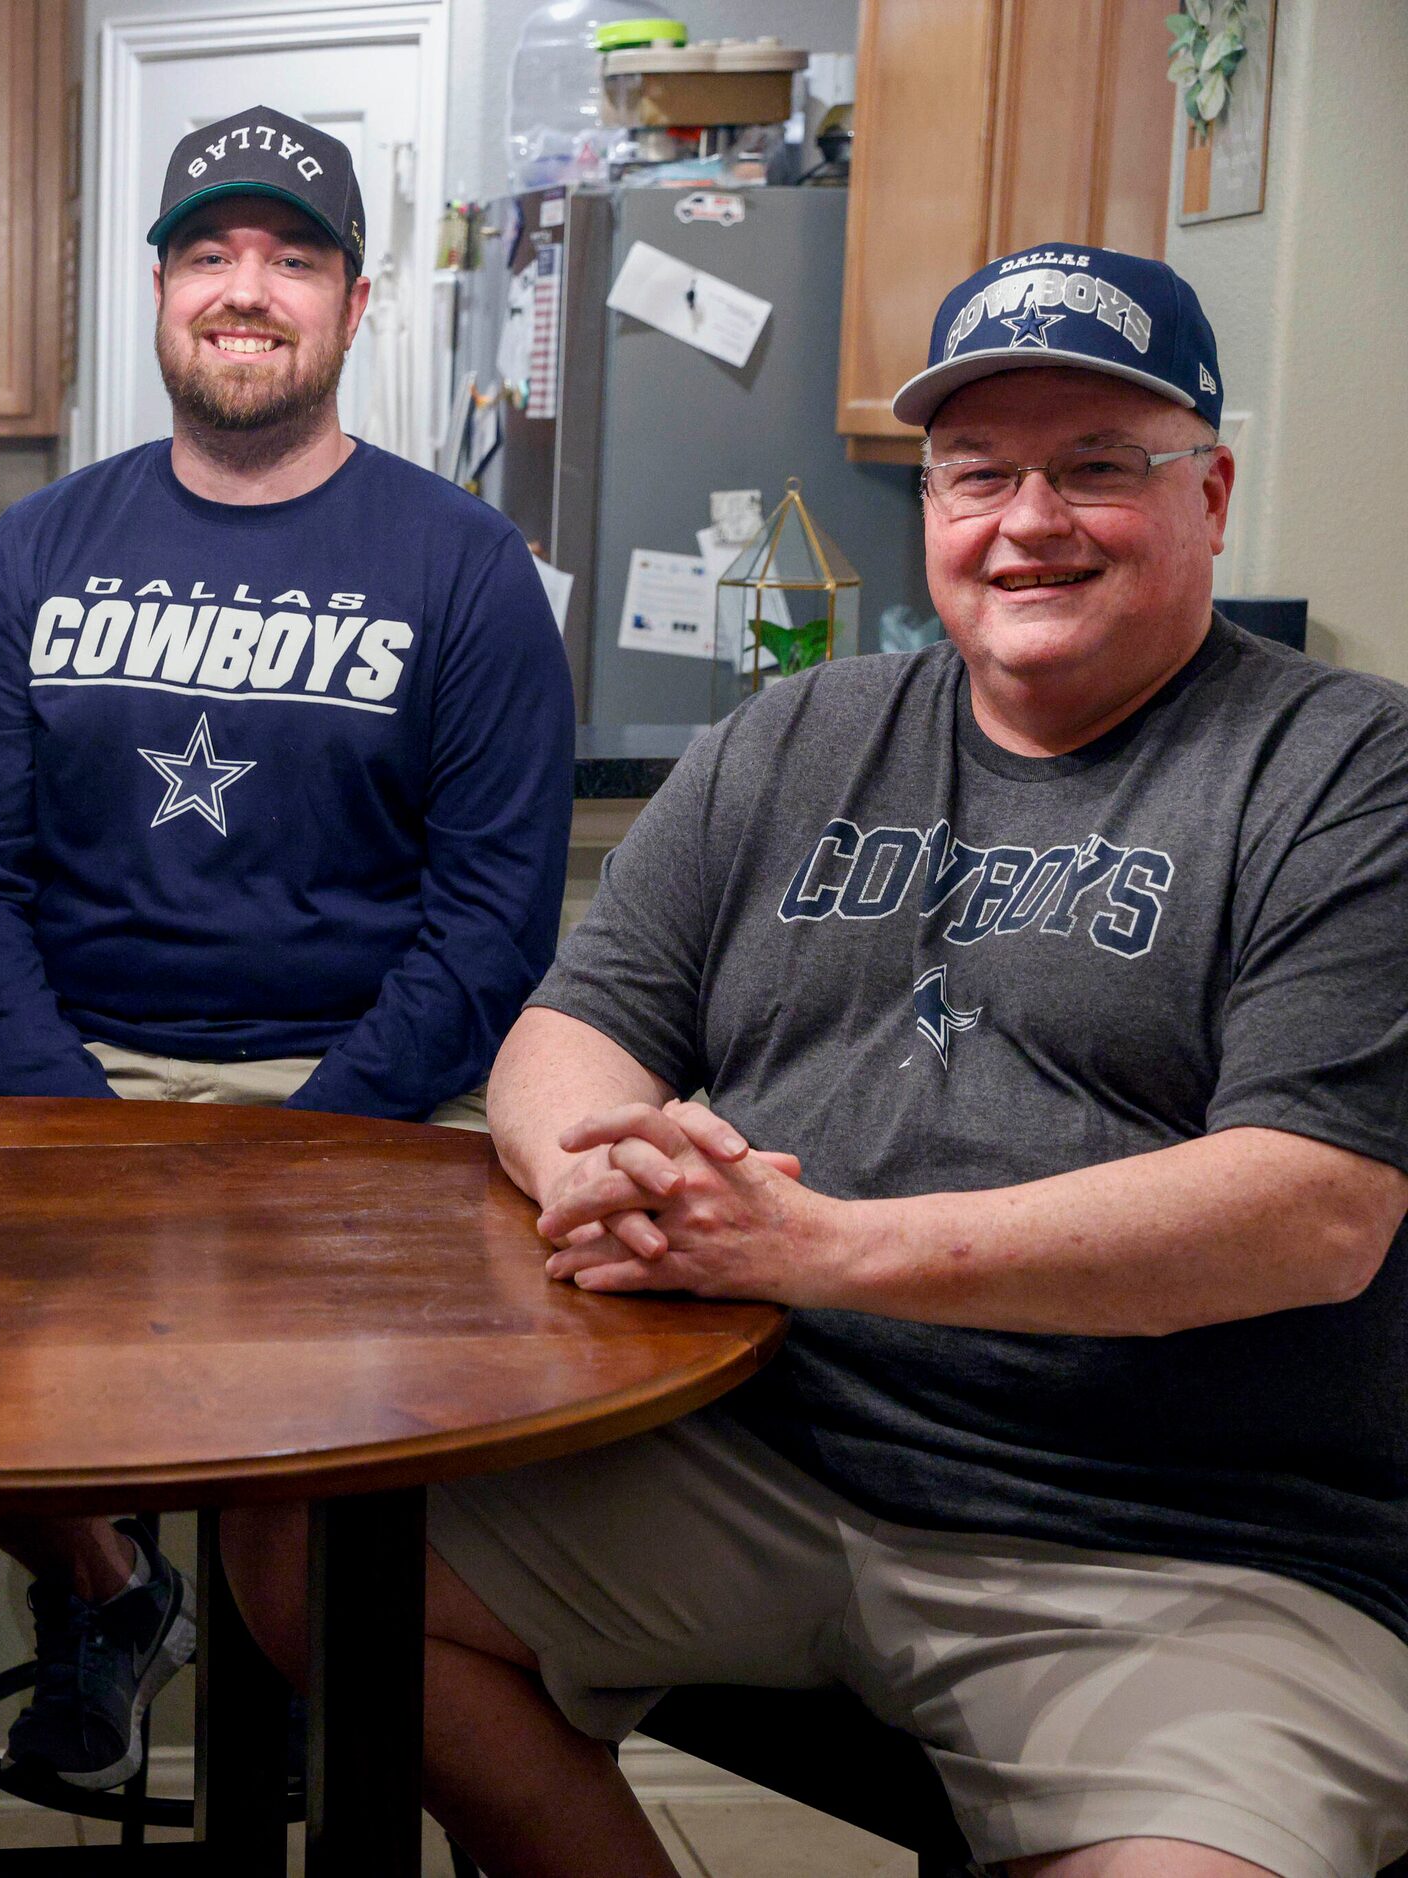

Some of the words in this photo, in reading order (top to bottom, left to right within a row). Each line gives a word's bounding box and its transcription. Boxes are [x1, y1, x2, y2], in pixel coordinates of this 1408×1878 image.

[188, 125, 324, 182] DALLAS
[999, 251, 1090, 274] DALLAS
[944, 268, 1152, 360] COWBOYS
[84, 575, 367, 610] DALLAS
[28, 596, 415, 701] COWBOYS
